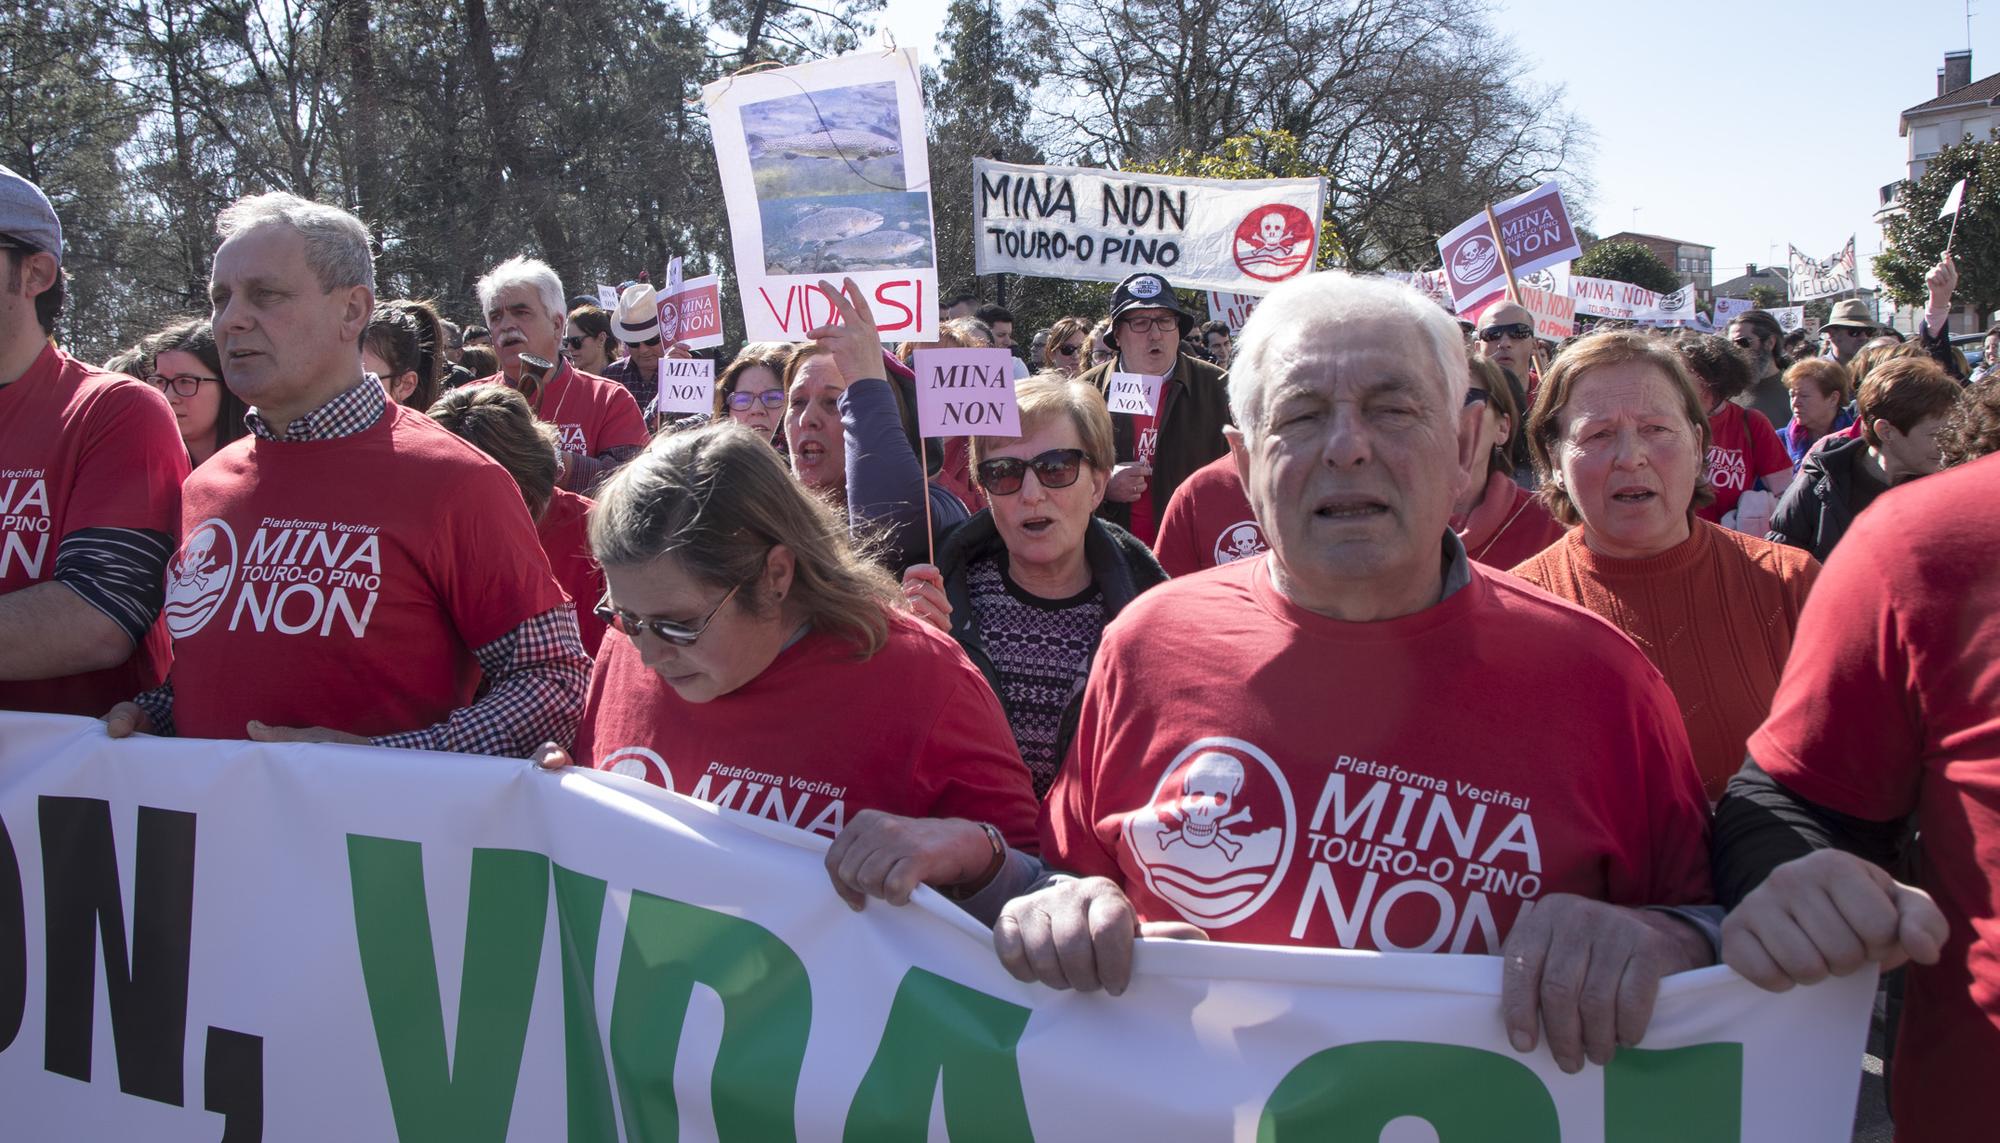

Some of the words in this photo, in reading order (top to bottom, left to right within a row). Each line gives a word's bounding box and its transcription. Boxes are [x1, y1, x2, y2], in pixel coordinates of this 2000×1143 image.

[979, 173, 1076, 223] MINA
[1101, 183, 1188, 232] NON
[1502, 209, 1554, 240] MINA
[1505, 228, 1537, 245] OURO-O
[986, 227, 1094, 261] TOURO-O
[1504, 225, 1561, 257] NON
[680, 297, 712, 314] MINA
[874, 279, 923, 334] SI
[1576, 281, 1614, 302] MINA
[1622, 286, 1656, 308] NON
[680, 313, 714, 333] NON
[666, 362, 709, 377] MINA
[930, 365, 1006, 389] MINA
[668, 385, 706, 400] NON
[1113, 382, 1152, 395] MINA
[940, 401, 1006, 426] NON
[564, 443, 587, 452] PINO
[1, 468, 46, 479] Veciñal
[1, 515, 51, 532] PINO
[260, 517, 328, 530] Plataforma
[331, 521, 381, 534] Veciñal
[243, 528, 381, 575] MINA
[241, 565, 324, 584] TOURO-O
[326, 569, 381, 591] PINO
[228, 582, 379, 639] NON
[706, 761, 784, 786] Plataforma
[788, 775, 847, 799] Veciñal
[1334, 755, 1448, 793] Plataforma
[1455, 780, 1531, 811] Veciñal
[689, 773, 847, 839] MINA
[1308, 772, 1543, 874] MINA
[1307, 832, 1455, 884] TOURO-O
[1461, 862, 1542, 899] PINO
[1289, 860, 1536, 954] NON
